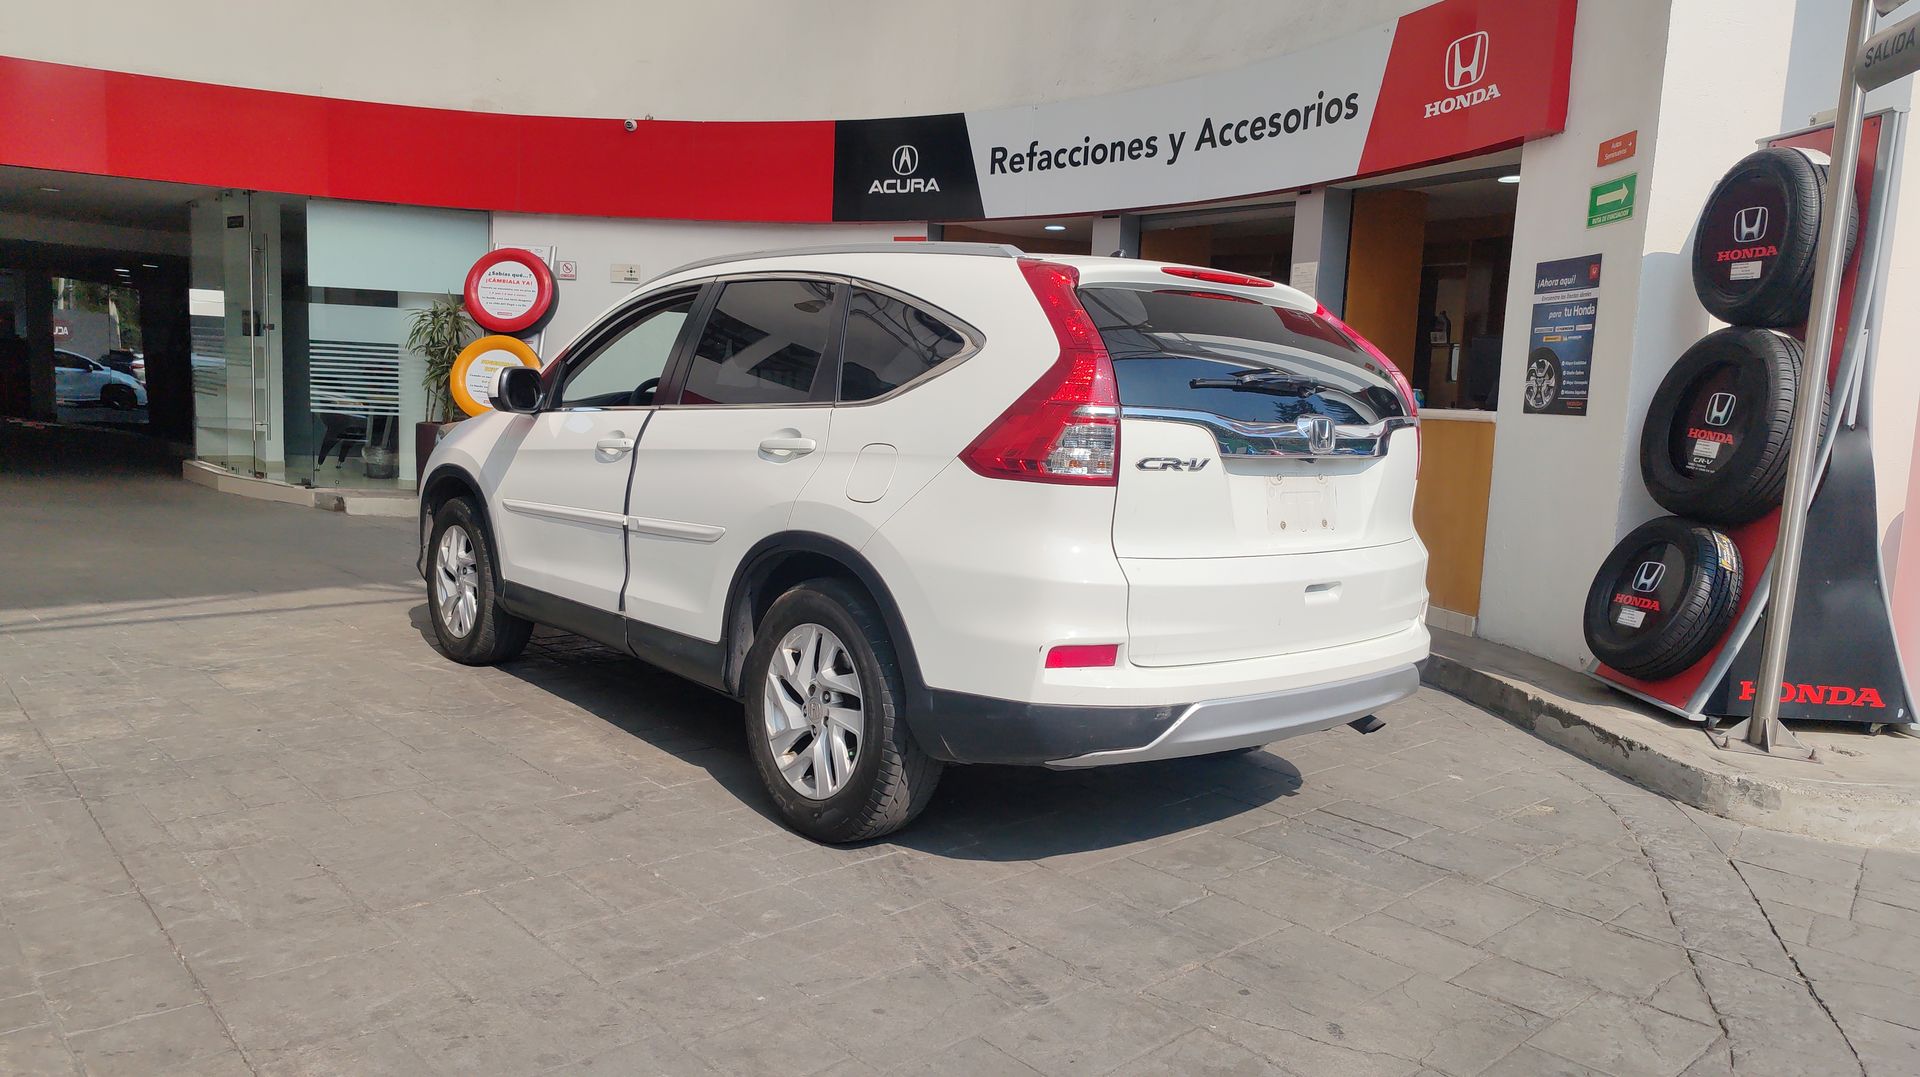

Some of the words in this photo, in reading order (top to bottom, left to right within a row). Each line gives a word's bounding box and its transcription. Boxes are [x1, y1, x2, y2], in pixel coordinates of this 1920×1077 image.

[1865, 27, 1916, 68] SALIDA
[1423, 83, 1501, 118] HONDA
[989, 137, 1158, 175] Refacciones
[1167, 131, 1186, 165] y
[1194, 91, 1359, 151] Accesorios
[868, 178, 941, 194] ACURA
[1717, 245, 1777, 261] HONDA
[1537, 277, 1559, 289] ¡Ahora
[1564, 307, 1573, 317] tu
[1573, 304, 1595, 317] Honda
[1687, 428, 1734, 445] HONDA
[1135, 457, 1211, 472] CR-V
[1693, 457, 1714, 465] CR-V
[1614, 593, 1661, 611] HONDA
